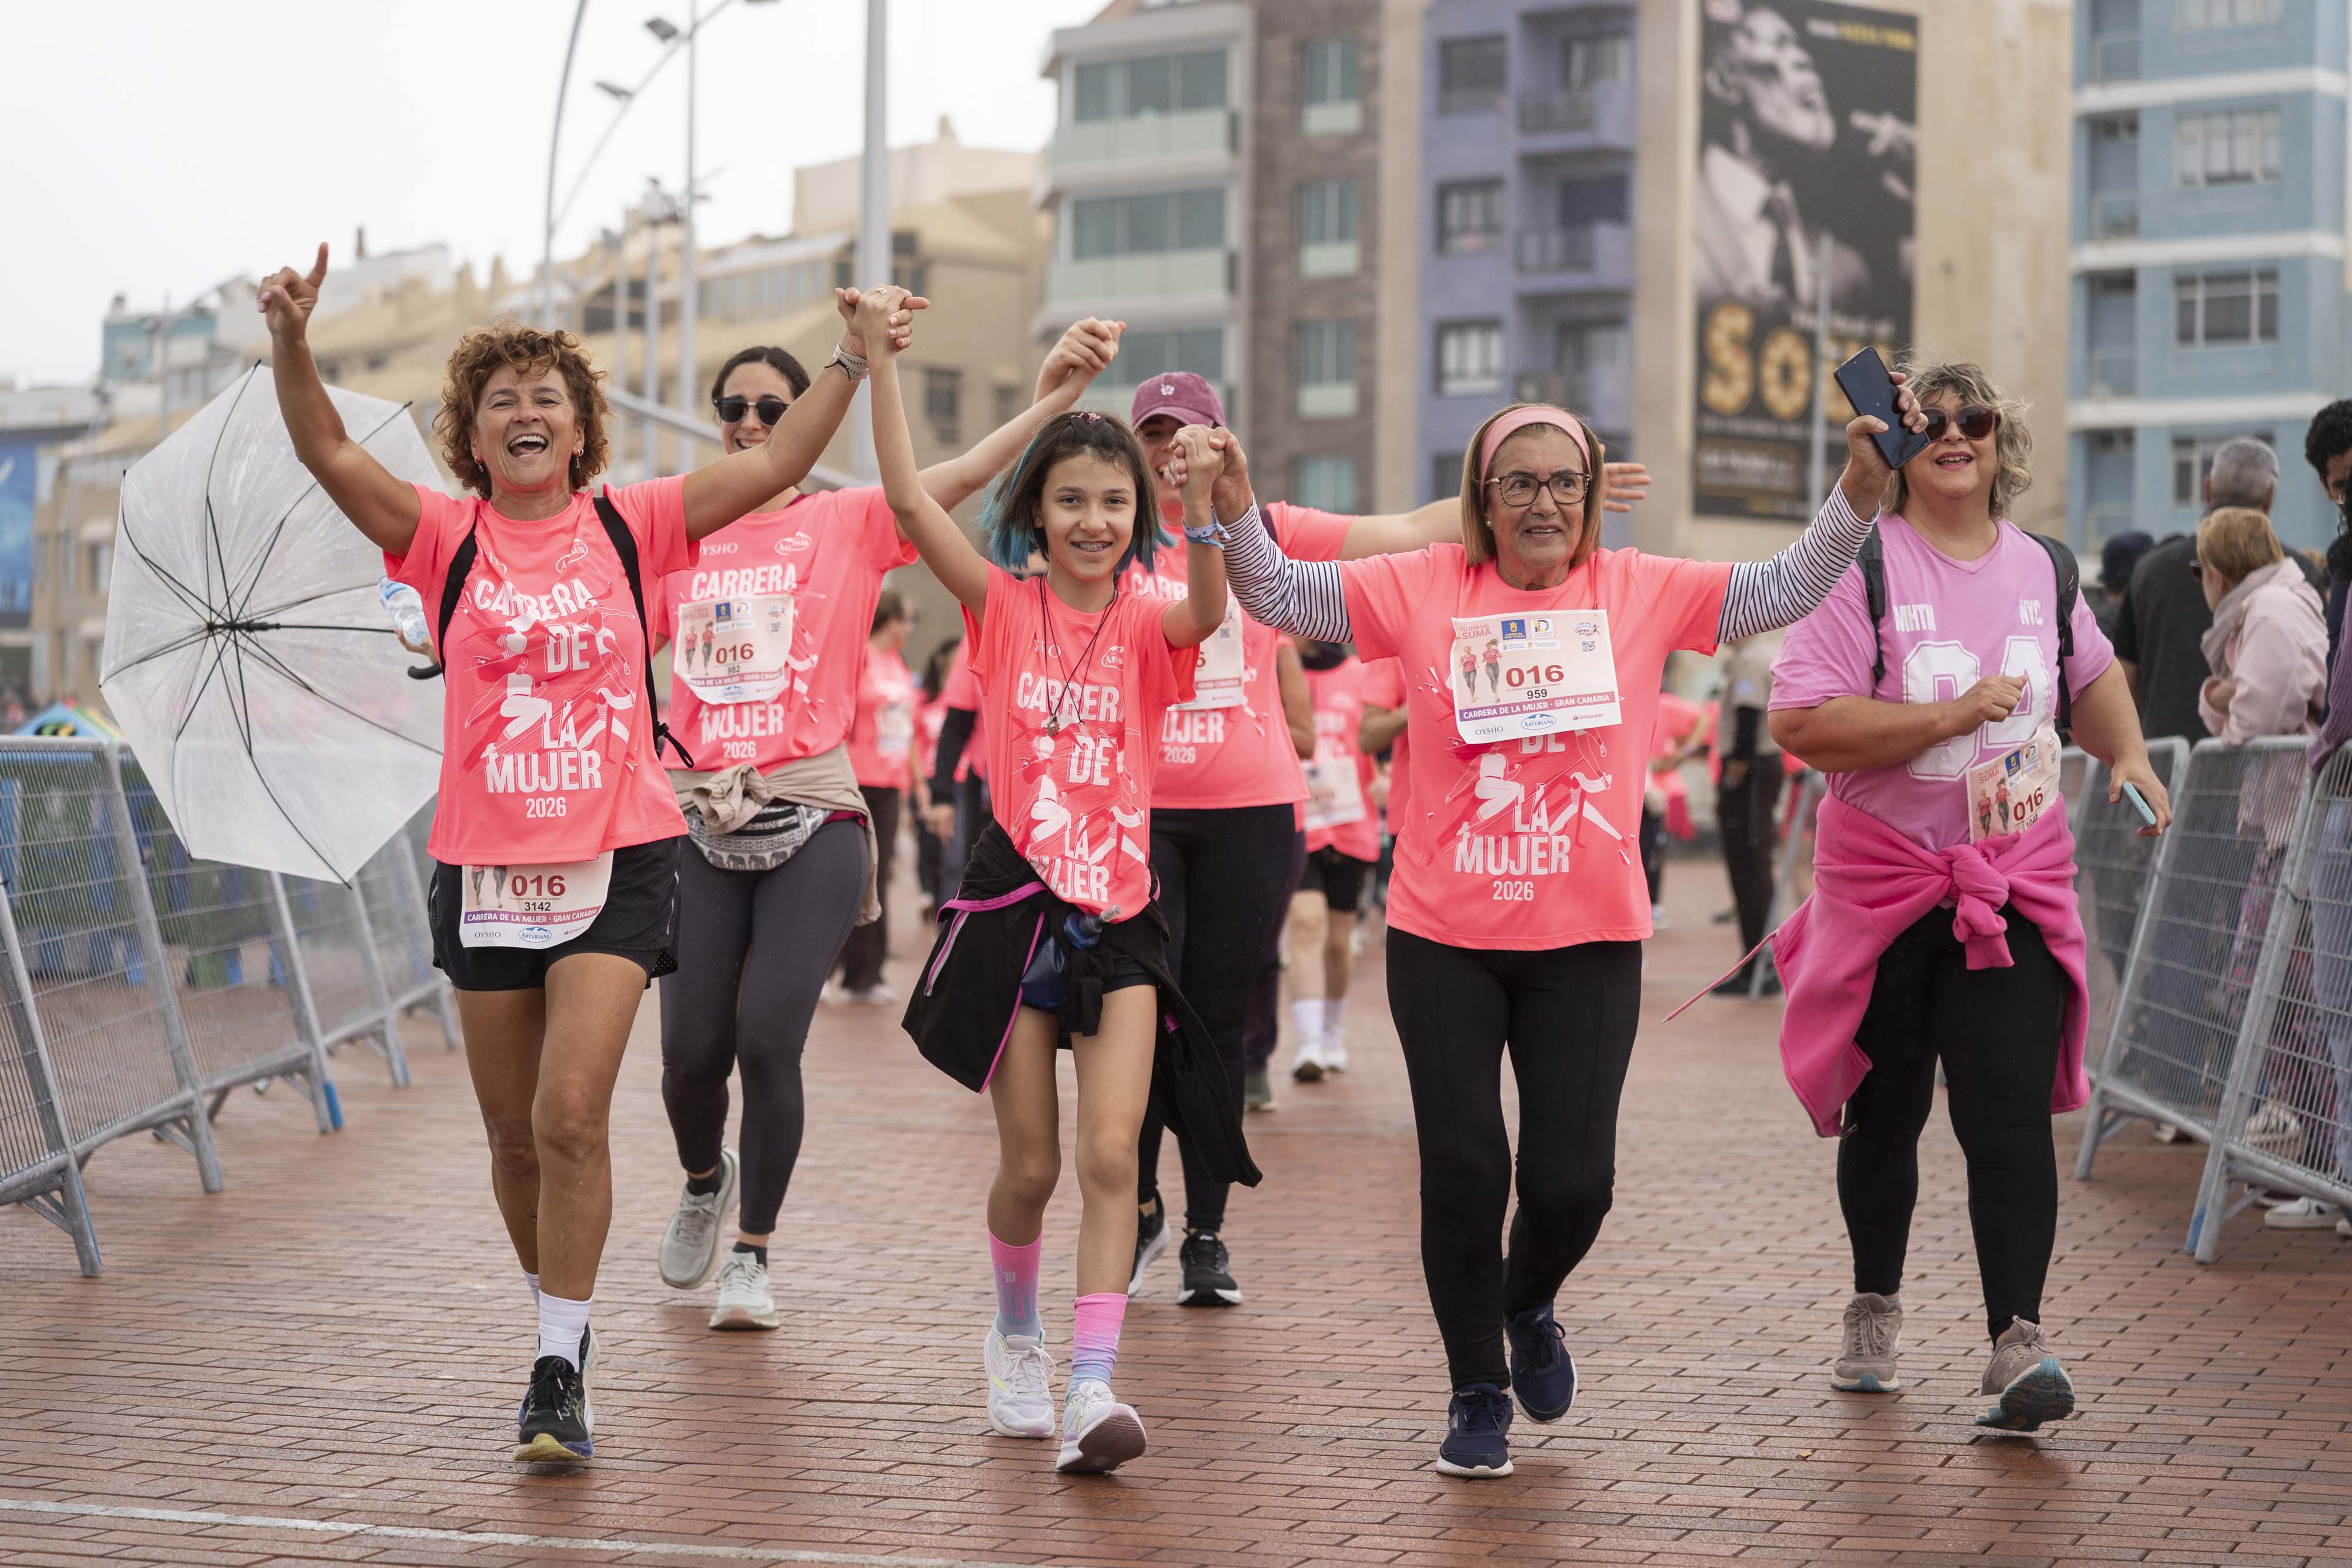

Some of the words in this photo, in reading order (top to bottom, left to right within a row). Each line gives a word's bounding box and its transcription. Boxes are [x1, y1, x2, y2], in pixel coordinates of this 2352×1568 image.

[474, 579, 598, 621] CARRERA
[1131, 573, 1188, 600] CARR
[1893, 604, 1936, 632] MHTN
[2019, 599, 2043, 626] NYC
[1462, 628, 1491, 640] SUMA
[544, 624, 592, 673] DE
[716, 643, 754, 664] 016
[1506, 665, 1565, 687] 016
[1017, 671, 1125, 723] CARRER
[1463, 709, 1498, 719] CARRERA
[1522, 702, 1548, 711] MUJER
[1554, 698, 1575, 707] GRAN
[1577, 695, 1610, 704] CANARIA
[1527, 689, 1547, 699] 959
[542, 700, 577, 748] LA
[701, 704, 784, 745] MUJER
[1162, 711, 1224, 743] UJER
[1475, 726, 1504, 735] OYSHO
[723, 741, 756, 759] 2026
[1067, 733, 1115, 786] DE
[1164, 746, 1196, 764] 2026
[485, 750, 602, 793] MUJER
[1979, 768, 1999, 784] SUMA
[526, 797, 566, 818] 2026
[1513, 783, 1549, 832] LA
[2014, 787, 2043, 821] 016
[1064, 814, 1089, 861] LA
[1454, 834, 1571, 875] MUJER
[511, 875, 566, 897] 016
[1493, 880, 1534, 901] 2026
[524, 902, 550, 911] 3142
[553, 914, 570, 922] GRAN
[572, 909, 596, 920] CANARIA
